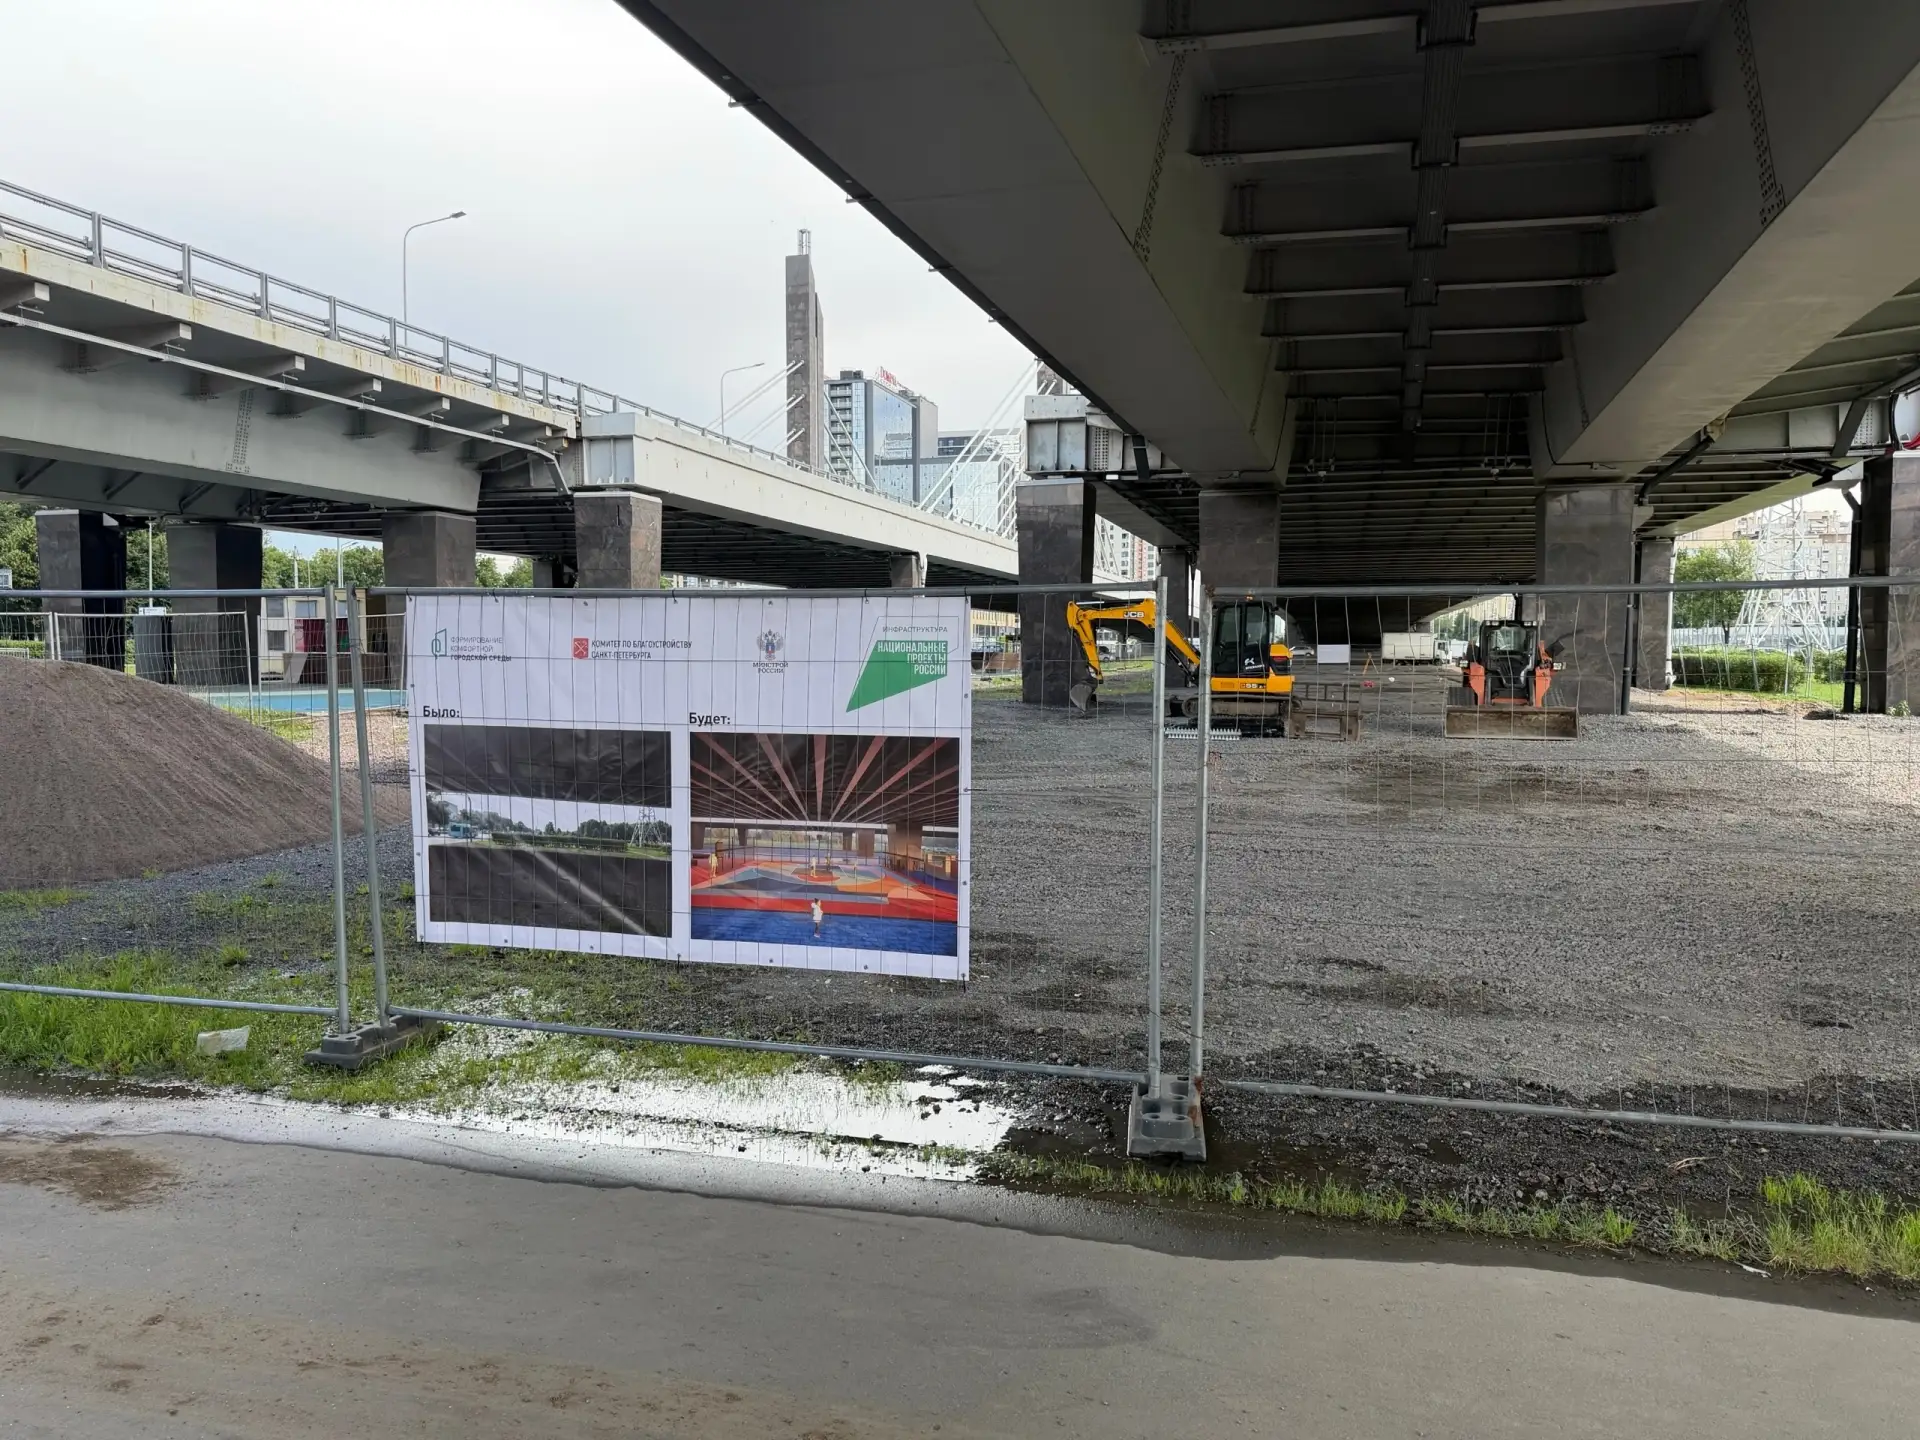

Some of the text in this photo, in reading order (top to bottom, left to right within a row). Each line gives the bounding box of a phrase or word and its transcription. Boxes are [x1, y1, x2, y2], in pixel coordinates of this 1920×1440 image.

[450, 636, 503, 644] ФОРМИРОВАНИЕ
[591, 639, 693, 649] КОМИТЕТ ПО БЛАГОУСТРОЙСТВУ
[877, 641, 947, 654] НАЦИОНАЛЬНЫЕ
[450, 653, 512, 662] ГОРОДСКОЙ СРЕДЫ
[591, 651, 652, 659] САНКТ-ПЕТЕРБУРГА
[907, 653, 947, 664] ПРОЕКТЫ
[914, 664, 947, 675] РОССИИ
[423, 705, 460, 718] Было:
[689, 711, 731, 727] Будет:
